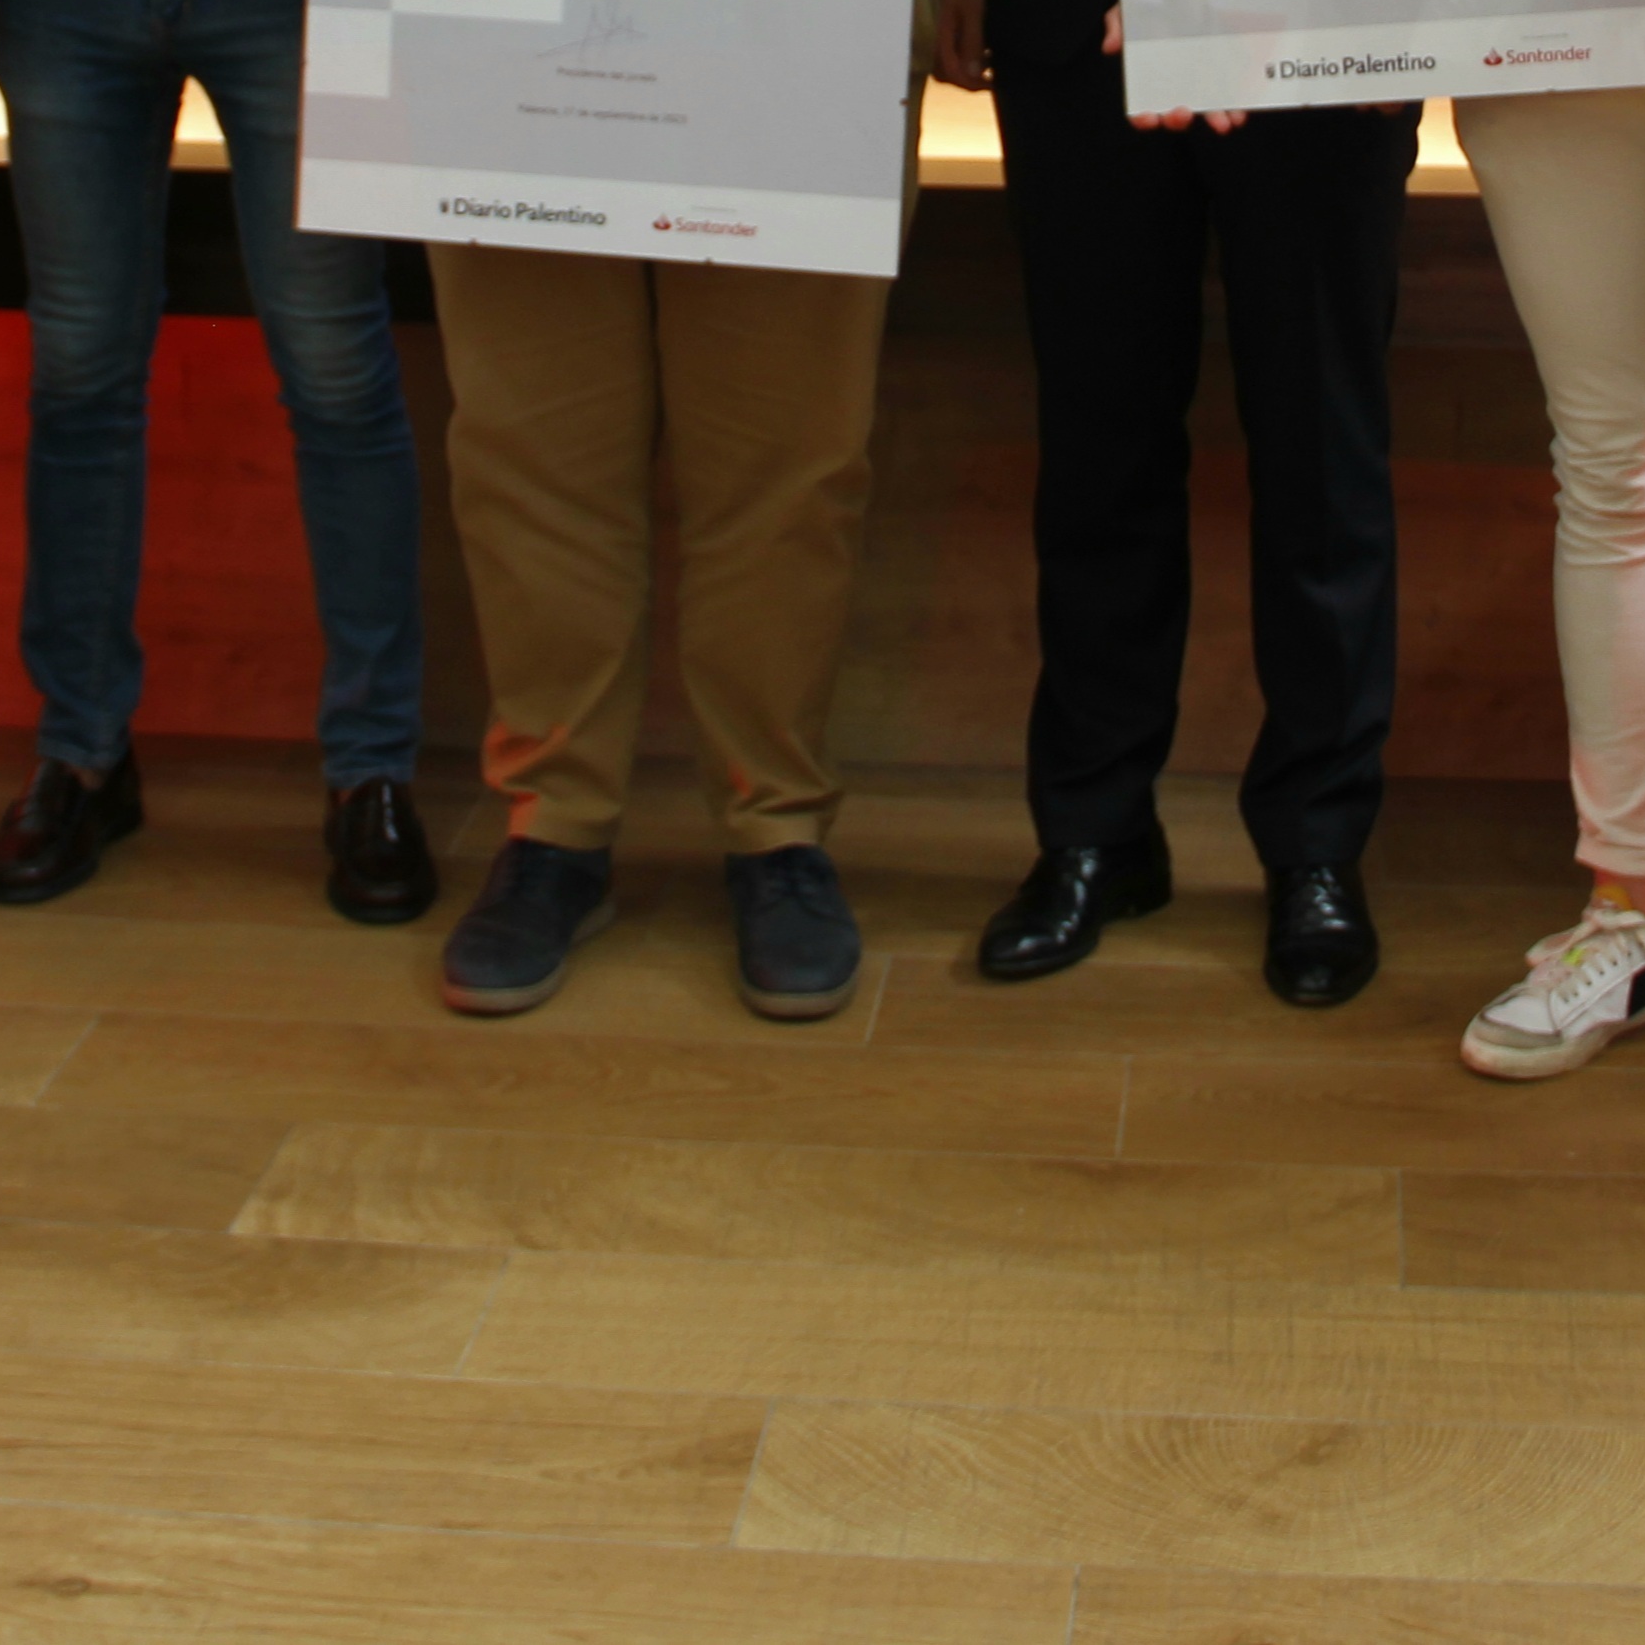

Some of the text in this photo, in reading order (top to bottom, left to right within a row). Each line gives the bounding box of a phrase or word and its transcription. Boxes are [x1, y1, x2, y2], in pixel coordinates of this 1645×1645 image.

[1280, 53, 1436, 79] Diario Palentino
[1506, 46, 1591, 65] Santander
[455, 197, 607, 226] Diario Palentino
[675, 216, 757, 236] Santander
